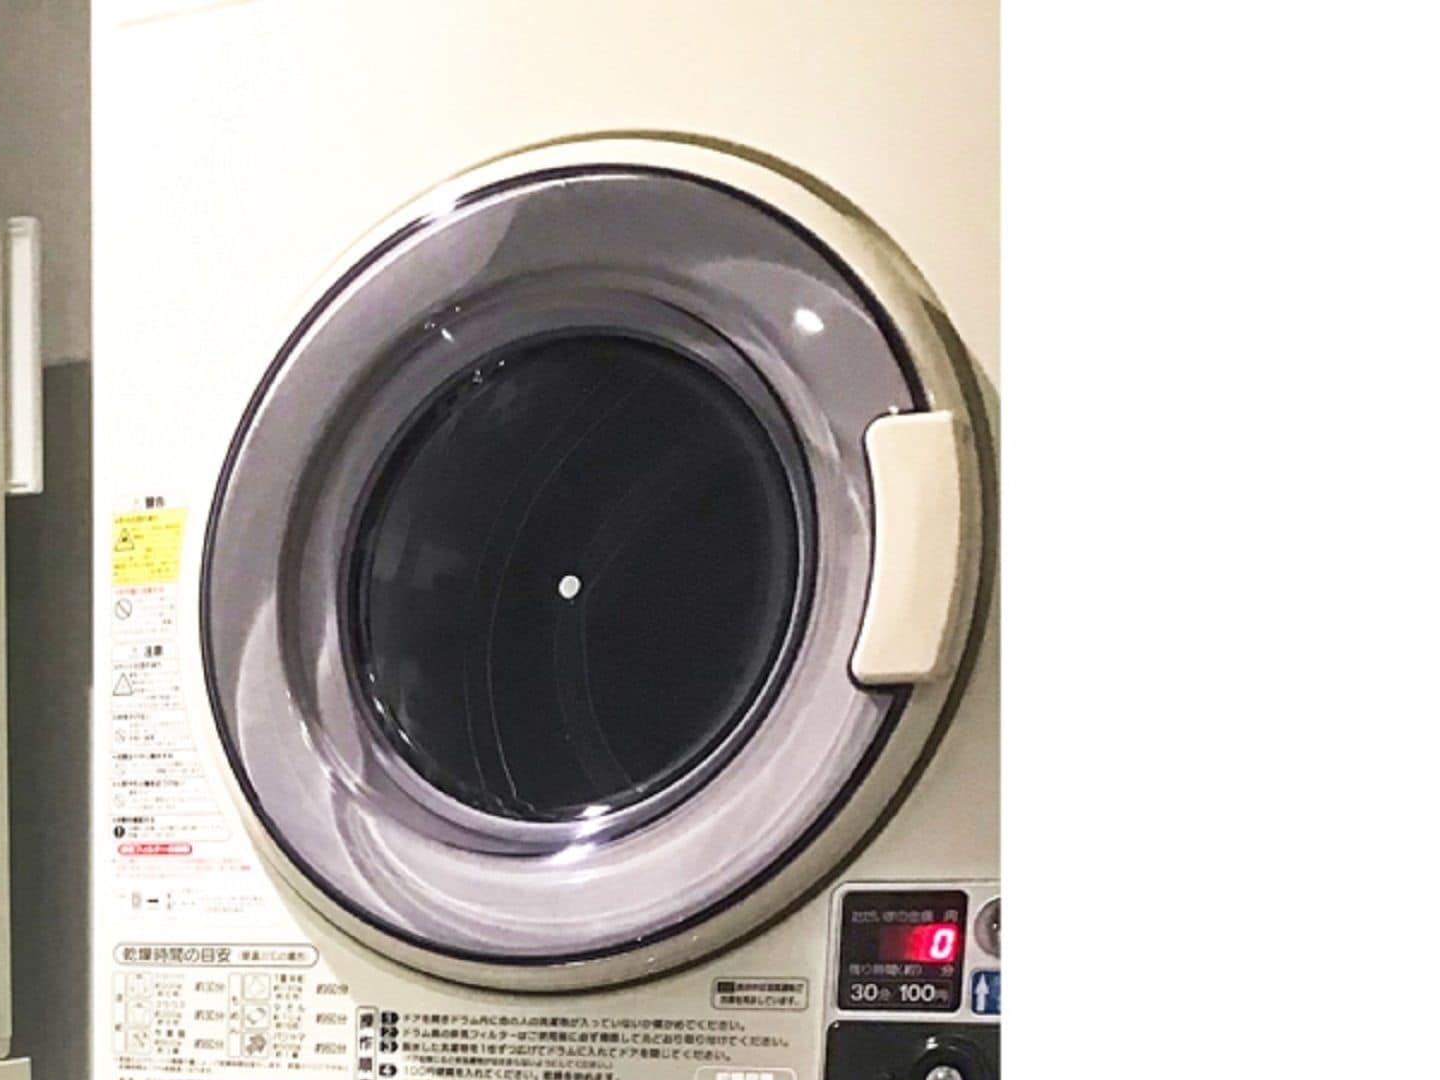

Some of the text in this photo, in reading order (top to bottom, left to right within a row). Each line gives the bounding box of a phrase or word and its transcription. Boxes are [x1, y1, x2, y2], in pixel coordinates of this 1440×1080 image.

[123, 947, 231, 963] 乾燥時間の目安
[930, 928, 956, 960] 0
